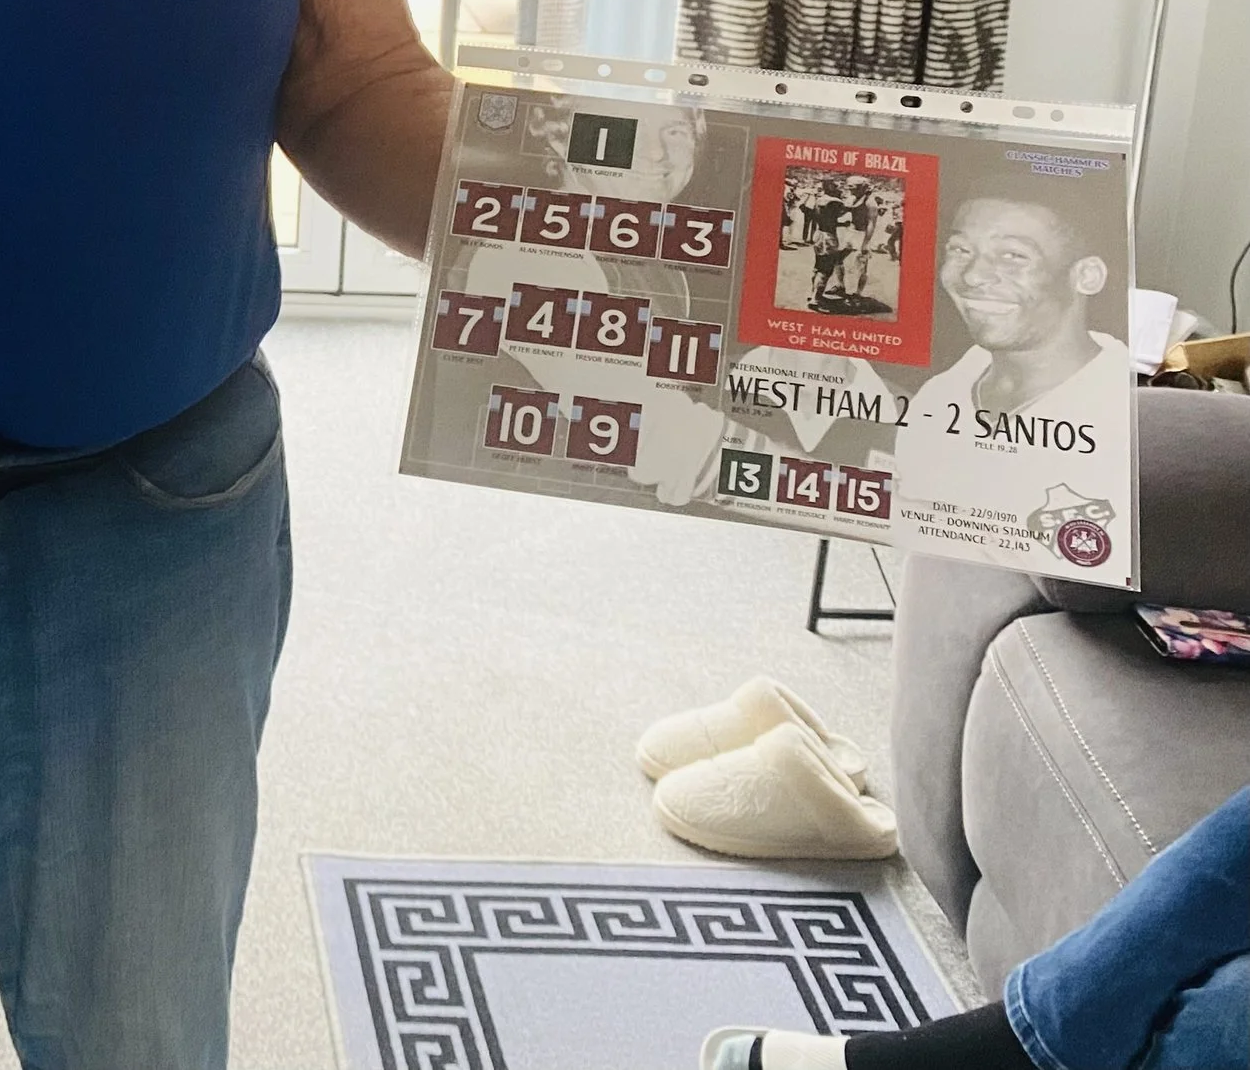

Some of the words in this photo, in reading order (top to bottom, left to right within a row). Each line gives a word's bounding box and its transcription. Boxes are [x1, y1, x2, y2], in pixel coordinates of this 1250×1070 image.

[595, 128, 608, 160] 1
[785, 144, 838, 165] SANTOS
[843, 150, 859, 167] OF
[864, 152, 910, 173] BRAZIL
[471, 197, 501, 233] 2
[539, 204, 571, 240] 5
[609, 213, 640, 248] 6
[680, 221, 713, 257] 3
[458, 307, 484, 345] 7
[526, 301, 554, 338] 4
[596, 309, 627, 347] 8
[669, 334, 699, 375] 11
[767, 319, 804, 333] WEST
[812, 326, 847, 339] HAM
[852, 331, 902, 346] UNITED
[789, 336, 807, 345] OF
[812, 338, 880, 356] ENGLAND
[729, 362, 799, 379] INTERNATIONAL
[801, 371, 846, 385] FRIENDLY
[499, 402, 543, 445] 10
[588, 414, 620, 455] 9
[728, 374, 805, 411] WEST
[816, 386, 882, 424] HAM
[894, 395, 910, 427] 2
[946, 403, 960, 435] 2
[974, 409, 1097, 454] SANTOS
[728, 460, 762, 494] 13
[786, 469, 820, 503] 14
[846, 477, 881, 512] 15
[901, 509, 936, 523] VENUE
[947, 516, 999, 534] DOWNING
[1002, 526, 1050, 542] STADIUM
[932, 501, 959, 515] DATE
[970, 506, 1018, 523] 22/9/1970
[918, 525, 986, 545] ATTENDANCE
